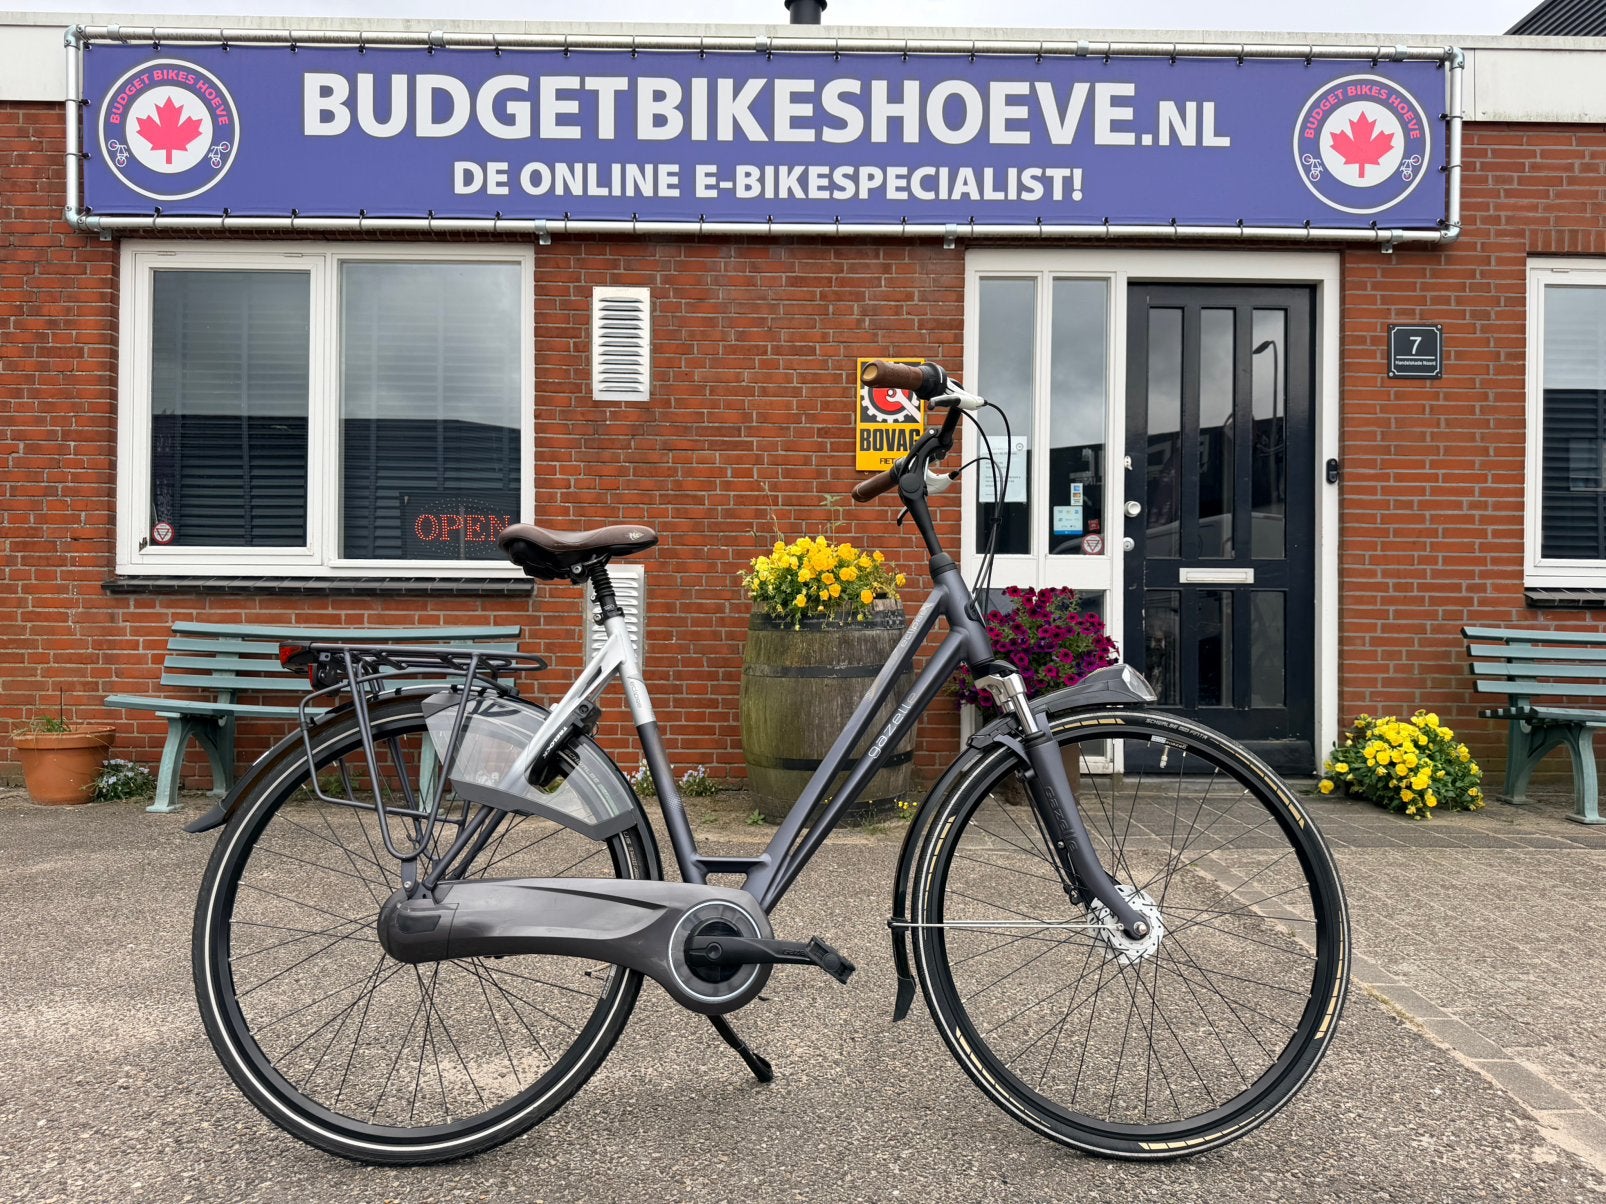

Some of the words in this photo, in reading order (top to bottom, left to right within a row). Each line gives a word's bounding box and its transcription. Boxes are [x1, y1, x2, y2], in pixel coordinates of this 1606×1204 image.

[110, 74, 150, 124] BUDGET
[153, 69, 196, 85] BIKES
[196, 80, 229, 126] HOEVE
[303, 72, 1231, 147] BUDGETBIKESHOEVE.NL
[1305, 89, 1344, 139] BUDGET
[1347, 85, 1388, 99] BIKES
[1389, 95, 1420, 139] HOEVE
[453, 160, 510, 196] DE
[520, 161, 681, 198] ONLINE
[694, 163, 1084, 202] E-BIKESPECIALIST!
[1409, 336, 1422, 355] 7
[415, 514, 511, 542] OPEN
[868, 692, 917, 759] gazelle
